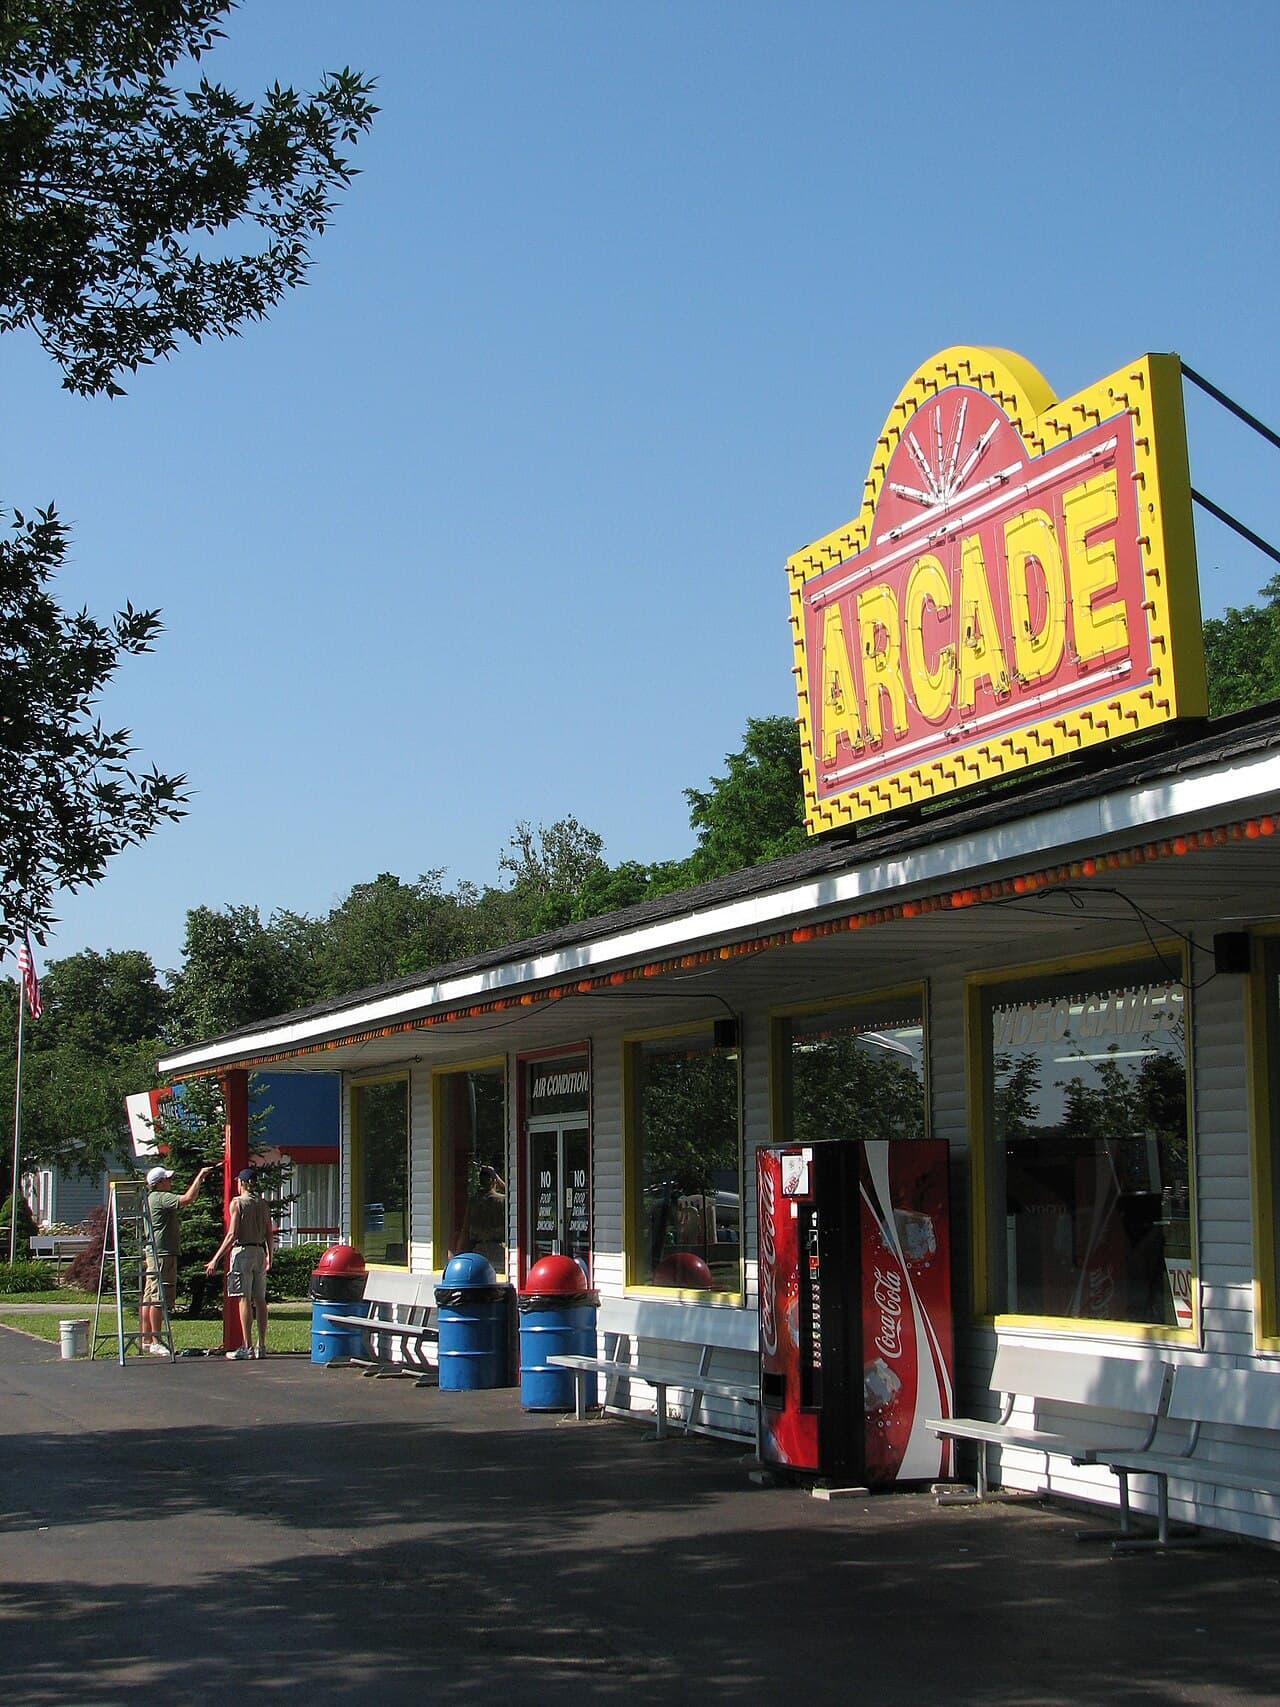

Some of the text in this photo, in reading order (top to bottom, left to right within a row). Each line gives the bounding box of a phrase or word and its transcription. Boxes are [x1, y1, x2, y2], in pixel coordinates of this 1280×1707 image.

[821, 467, 1130, 764] ARCADE
[993, 984, 1184, 1045] VIDEO GAMES
[532, 1077, 546, 1098] AIR
[540, 1170, 551, 1188] NO
[574, 1169, 586, 1188] NO
[540, 1192, 551, 1204] FOOD
[573, 1192, 586, 1204] FOOD
[873, 1264, 902, 1359] Coca-Cola
